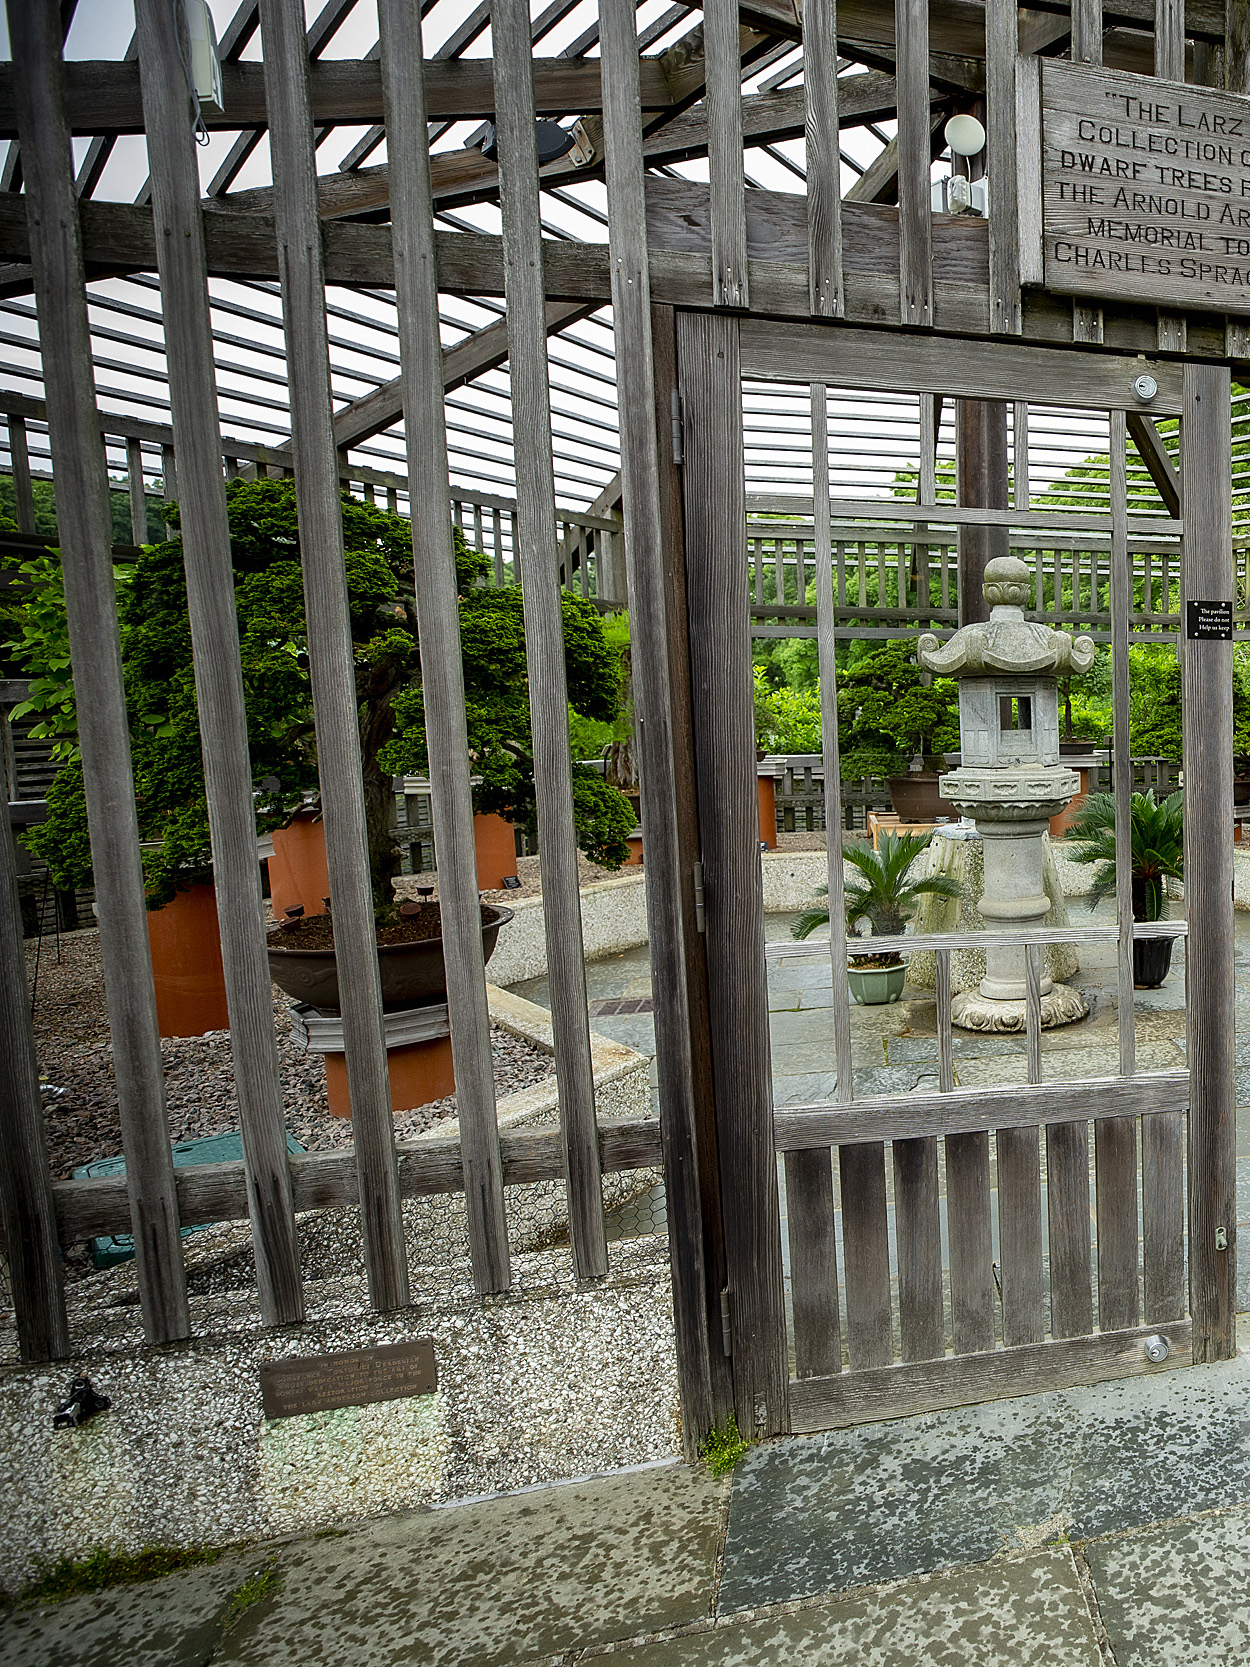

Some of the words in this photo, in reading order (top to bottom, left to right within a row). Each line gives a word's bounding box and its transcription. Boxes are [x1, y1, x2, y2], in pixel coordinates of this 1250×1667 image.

[1178, 104, 1243, 137] LARZ
[1078, 119, 1232, 165] COLLECTION
[1061, 150, 1147, 180] DWARF
[1154, 165, 1232, 194] TREES
[1055, 181, 1104, 205] THE
[1113, 187, 1210, 220] ARNOLD
[1088, 217, 1213, 251] MEMORIAL
[1219, 236, 1250, 256] TO
[1055, 242, 1171, 275] CHARLES
[1199, 624, 1211, 632] Help
[308, 1373, 355, 1386] DEDICATION
[371, 1384, 418, 1396] COLLECTION
